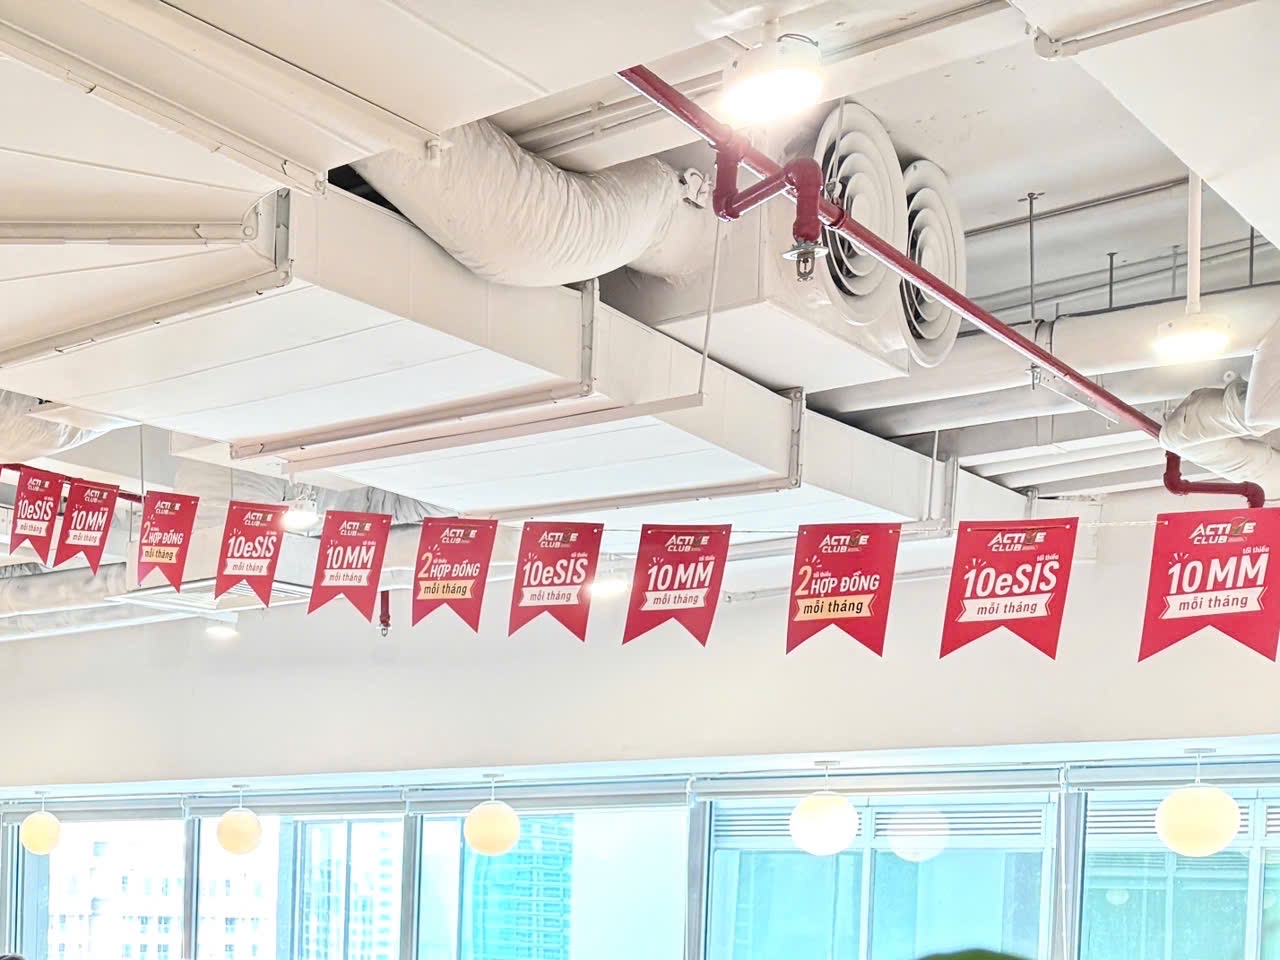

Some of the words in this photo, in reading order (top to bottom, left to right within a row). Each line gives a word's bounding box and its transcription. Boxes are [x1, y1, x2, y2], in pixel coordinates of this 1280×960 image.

[18, 499, 54, 520] 10eSIS
[71, 511, 86, 529] 10
[85, 511, 108, 530] MM
[227, 536, 277, 557] 10eSIS
[992, 544, 1022, 552] CLUB
[1194, 536, 1228, 544] CLUB
[326, 546, 344, 568] 10
[343, 546, 376, 568] MM
[418, 552, 432, 578] 2
[430, 564, 451, 580] HỢP
[452, 560, 480, 577] ĐỒNG
[523, 558, 588, 586] 10eSIS
[648, 565, 673, 591] 10
[673, 561, 715, 589] MM
[795, 565, 812, 596] 2
[811, 577, 837, 597] HỢP
[840, 571, 880, 592] ĐỒNG
[964, 561, 1060, 598] 10eSIS
[1168, 560, 1203, 594] 10
[1206, 553, 1269, 591] MM
[803, 600, 824, 614] mỗi
[828, 600, 863, 613] tháng
[977, 602, 999, 615] mỗi
[1004, 602, 1037, 614] tháng
[1179, 596, 1203, 611] mỗi
[1208, 595, 1248, 608] tháng
